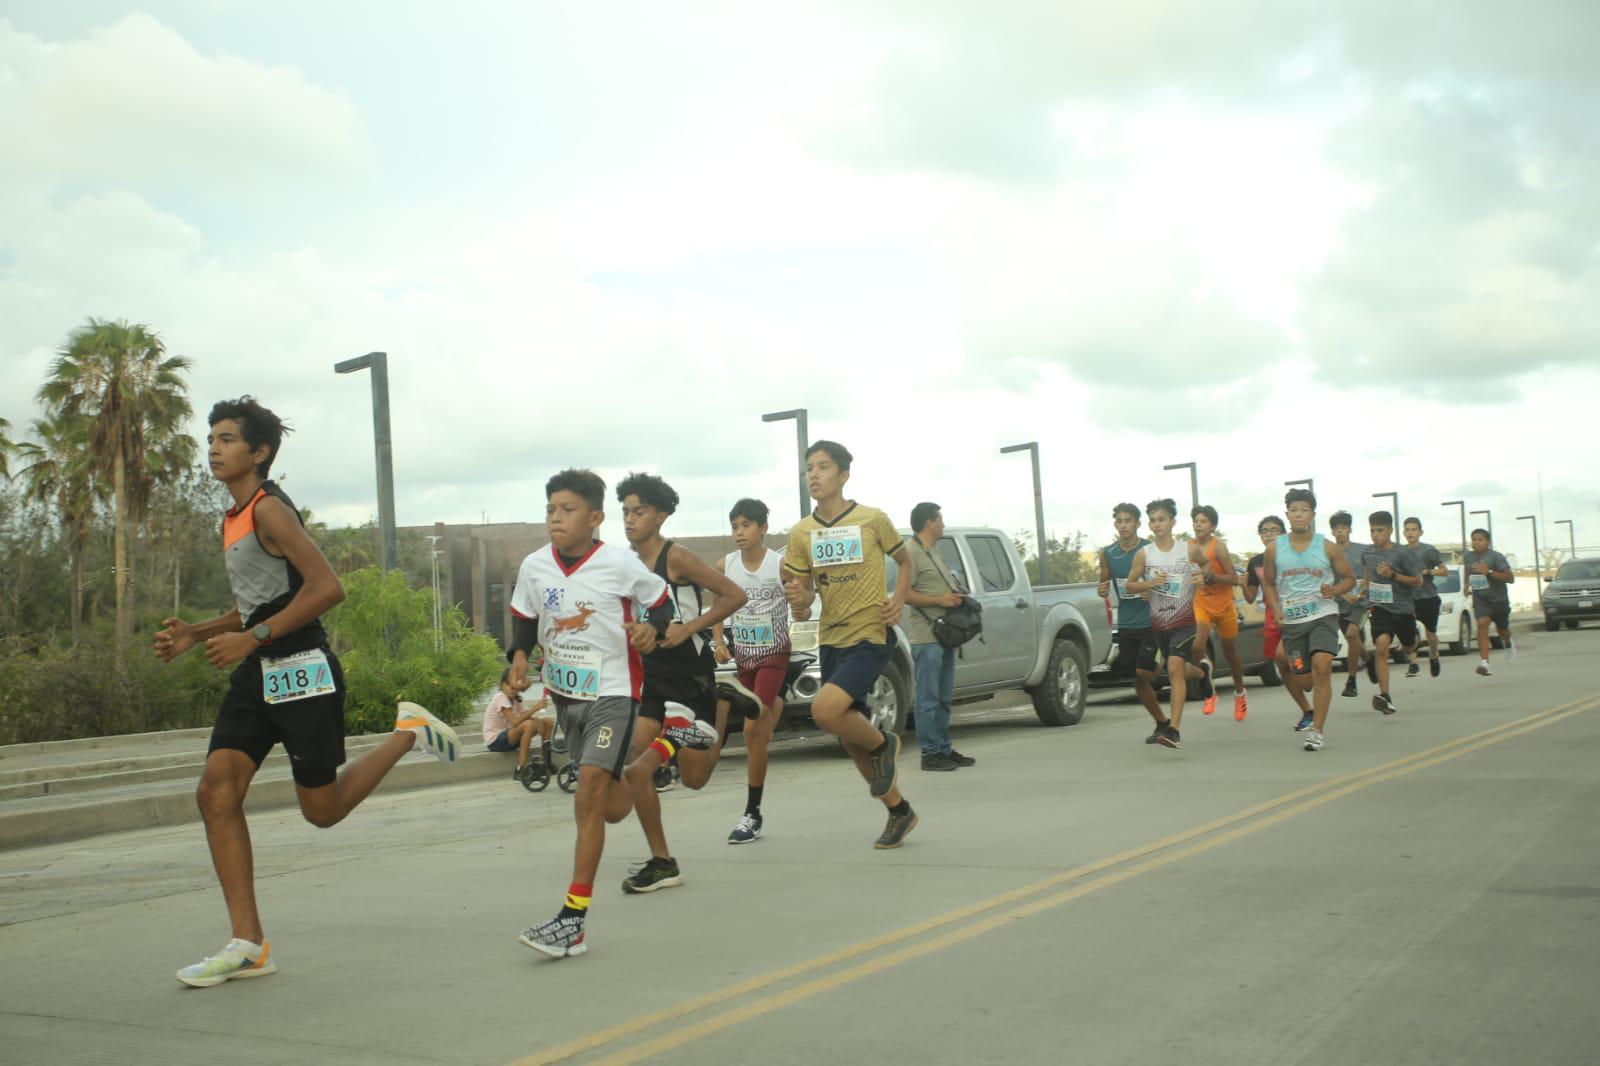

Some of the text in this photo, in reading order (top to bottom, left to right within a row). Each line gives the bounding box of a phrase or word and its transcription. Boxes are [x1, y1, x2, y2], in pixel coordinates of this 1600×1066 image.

[816, 542, 845, 559] 303
[1288, 605, 1309, 617] 328
[735, 626, 757, 641] 301
[269, 669, 309, 693] 318
